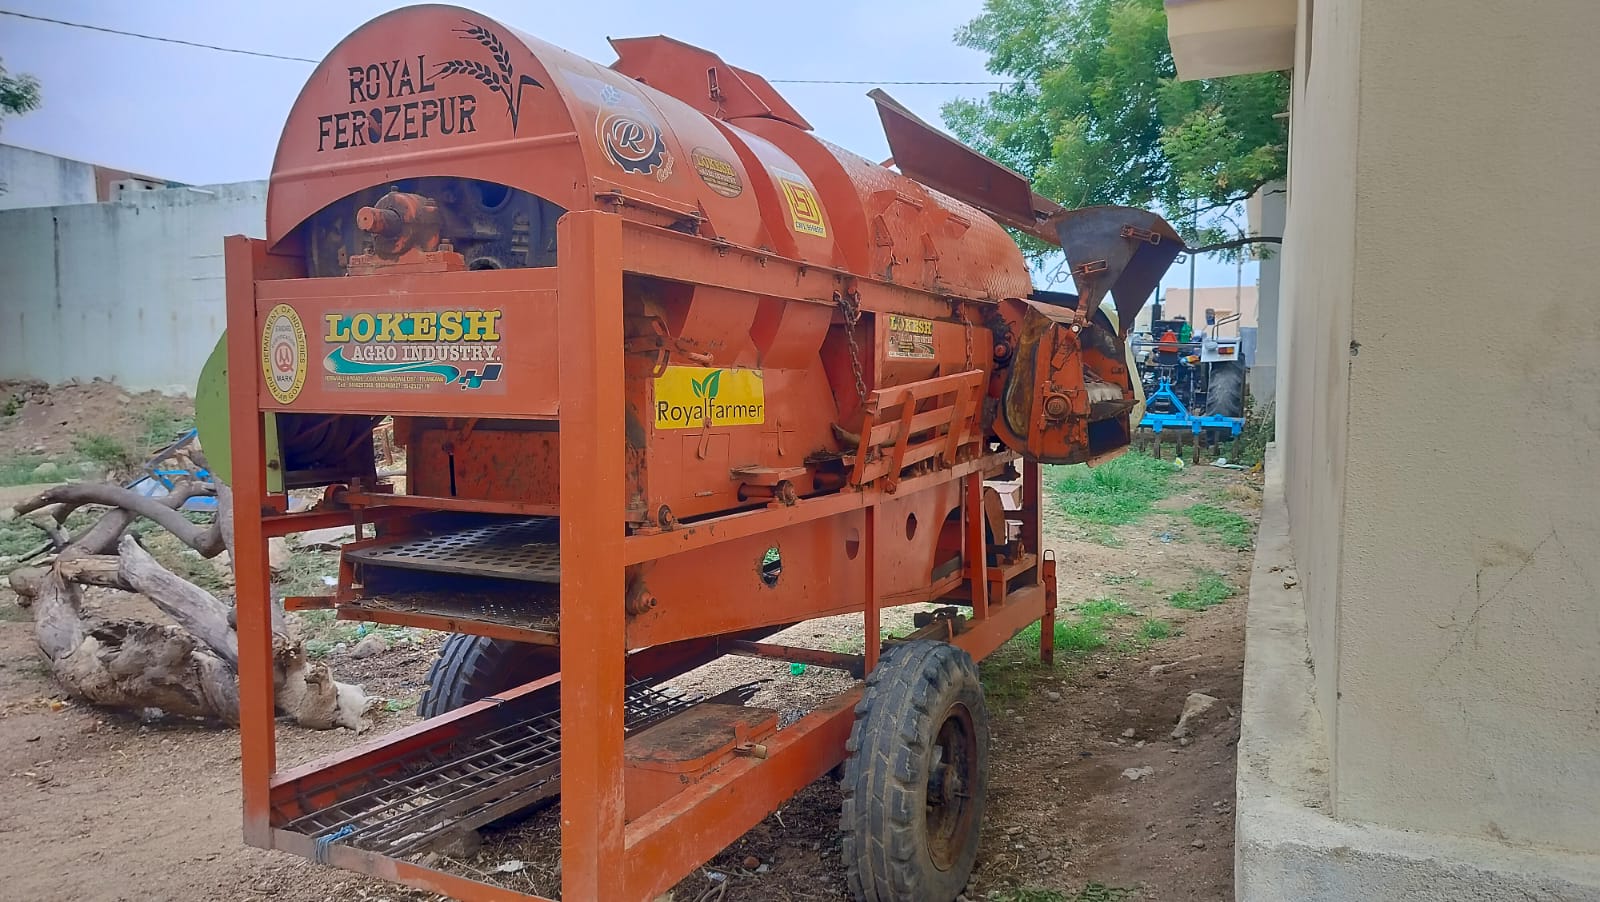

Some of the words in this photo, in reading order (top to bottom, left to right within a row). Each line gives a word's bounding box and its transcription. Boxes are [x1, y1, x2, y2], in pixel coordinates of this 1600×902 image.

[348, 54, 435, 105] ROYAL
[316, 94, 477, 152] FEROZEPUR
[324, 311, 501, 343] LOKESH
[889, 315, 933, 335] LOKESH
[352, 346, 397, 362] AGRO
